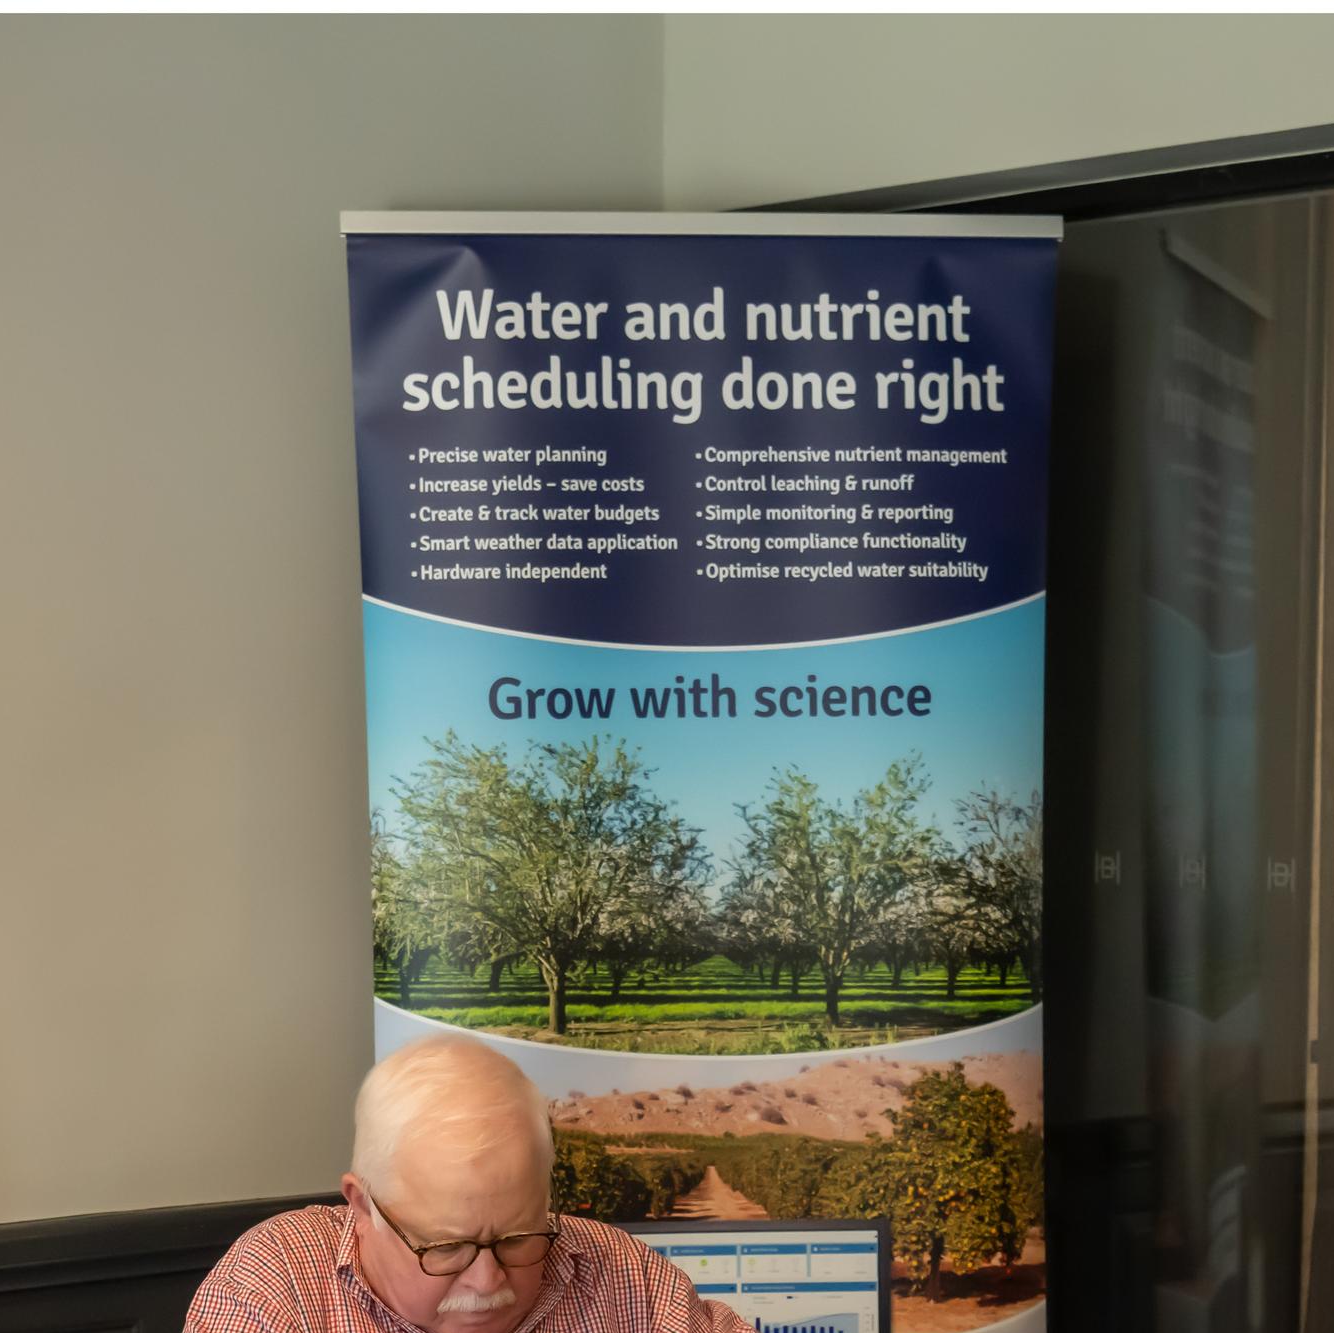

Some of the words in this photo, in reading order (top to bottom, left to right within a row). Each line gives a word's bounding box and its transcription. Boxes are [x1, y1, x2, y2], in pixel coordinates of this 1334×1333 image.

[436, 289, 608, 340] Water
[625, 287, 726, 341] and
[747, 290, 971, 343] nutrient
[402, 356, 703, 425] scheduling
[722, 357, 857, 410] done
[875, 358, 1005, 425] right
[419, 446, 479, 464] Precise
[482, 448, 532, 463] water
[535, 445, 607, 467] planning
[705, 445, 831, 467] Comprehensive
[834, 445, 903, 462] nutrient
[906, 448, 1008, 467] management
[419, 476, 488, 493] Increase
[491, 474, 542, 496] yields
[561, 478, 598, 492] save
[601, 476, 645, 492] costs
[705, 474, 767, 492] Control
[771, 474, 841, 496] leaching
[844, 474, 858, 491] &
[861, 473, 915, 491] runoff
[420, 505, 474, 522] Create
[477, 504, 491, 521] &
[494, 503, 539, 521] track
[542, 505, 591, 521] water
[594, 503, 660, 525] budgets
[706, 504, 762, 525] Simple
[765, 504, 857, 524] monitoring
[860, 503, 874, 520] &
[877, 503, 954, 525] reporting
[420, 534, 471, 551] Smart
[474, 533, 543, 551] weather
[546, 533, 583, 550] data
[587, 533, 679, 555] application
[706, 532, 761, 554] Strong
[764, 532, 859, 554] compliance
[862, 531, 968, 554] functionality
[421, 563, 502, 581] Hardware
[505, 562, 608, 583] independent
[706, 562, 780, 583] Optimise
[784, 561, 853, 583] recycled
[856, 563, 906, 580] water
[908, 561, 989, 583] suitability
[488, 676, 616, 720] Grow
[629, 673, 737, 719] with
[754, 672, 933, 718] science
